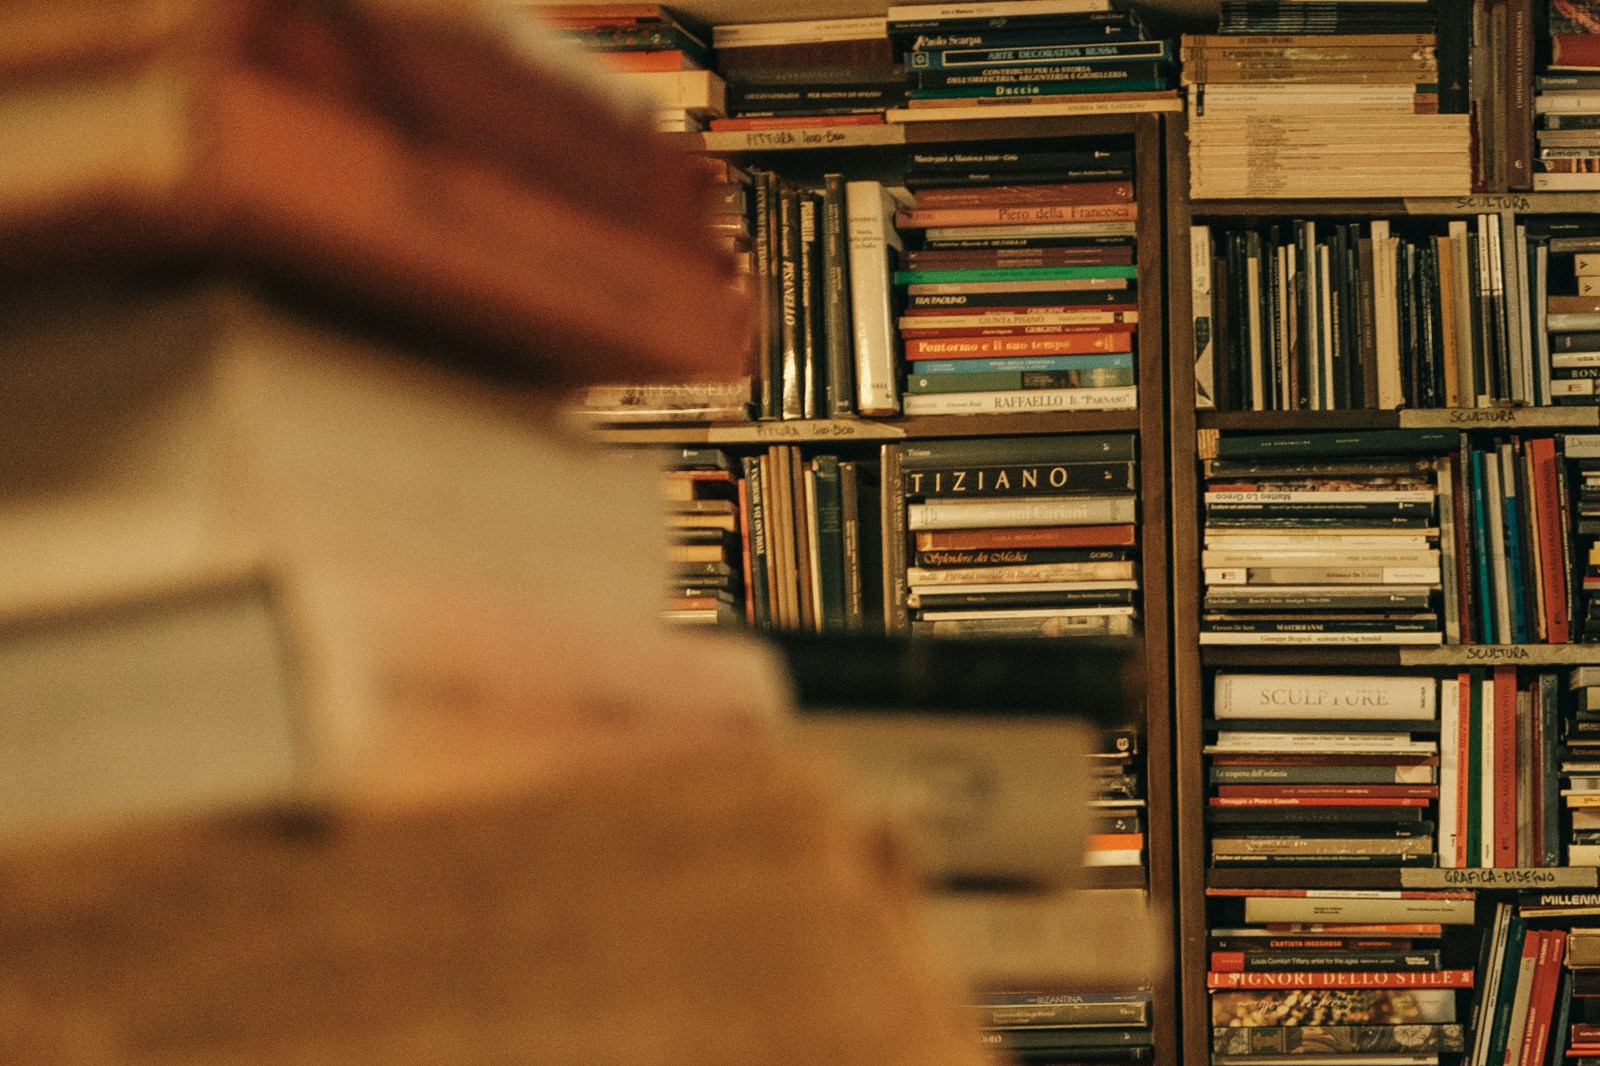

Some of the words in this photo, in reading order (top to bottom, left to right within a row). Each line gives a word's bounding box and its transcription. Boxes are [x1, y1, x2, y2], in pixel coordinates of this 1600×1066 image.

[995, 84, 1040, 95] Duccio
[1456, 196, 1530, 210] SCULTURA
[998, 207, 1030, 220] Piero
[1035, 206, 1064, 219] della
[1070, 204, 1130, 218] Francesca
[918, 341, 978, 354] Pontormo
[1450, 410, 1516, 422] SCULTURA
[910, 467, 1069, 493] TIZIANO
[1215, 493, 1244, 501] Greco
[1246, 493, 1258, 501] Lo
[1260, 492, 1292, 501] Matteo
[923, 553, 974, 566] Splendore
[975, 552, 989, 564] dei
[1466, 648, 1530, 660] SCULTURA
[1259, 688, 1389, 706] SCULPTURE
[1444, 870, 1556, 884] GRAFICA-DISEGNO
[1270, 940, 1303, 948] L'ARTISTA
[1251, 957, 1267, 966] Louis
[1291, 957, 1310, 967] Tiffany
[1227, 972, 1314, 985] SIGNORI
[1323, 972, 1388, 985] DELLO
[1395, 971, 1454, 984] STILE
